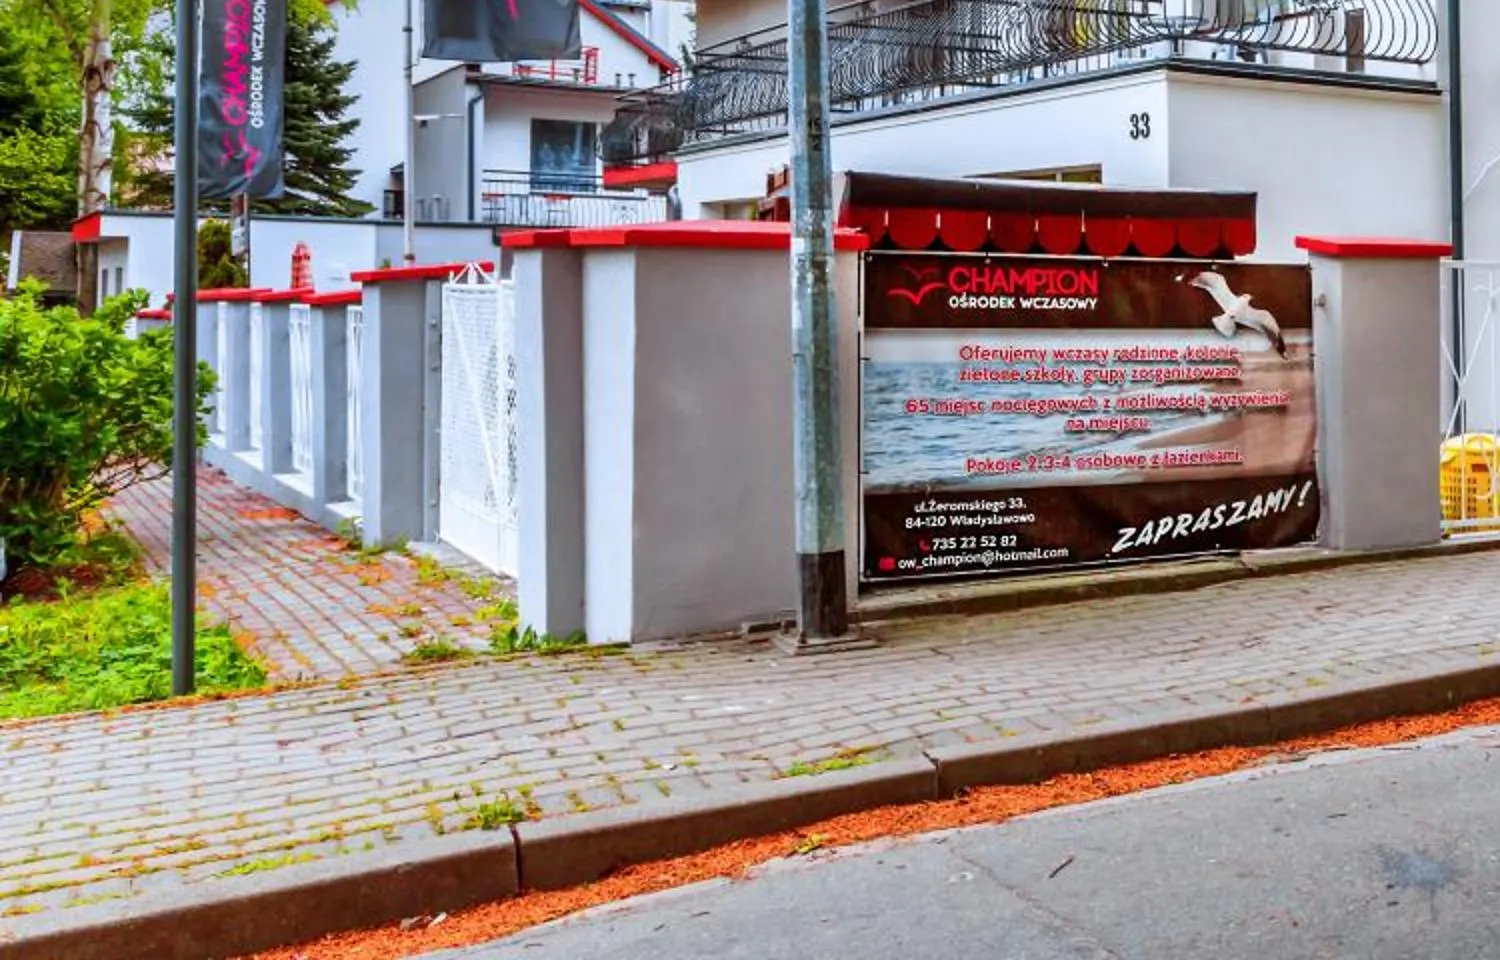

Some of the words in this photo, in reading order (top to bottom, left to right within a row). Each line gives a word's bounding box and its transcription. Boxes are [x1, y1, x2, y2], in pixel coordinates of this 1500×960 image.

[247, 66, 265, 129] OŚRODEK
[1129, 112, 1151, 140] 33
[948, 266, 1099, 295] CHAMPION
[949, 292, 1016, 309] OŚRODEK
[1020, 296, 1098, 310] WCZASOWY
[959, 345, 1047, 364] Oferujemy
[1053, 347, 1110, 364] wczasy
[1083, 368, 1126, 385] grupy
[904, 398, 929, 414] 65
[934, 397, 985, 415] miejsc
[1103, 397, 1111, 410] z
[1065, 418, 1085, 431] na
[965, 457, 1022, 474] Pokoje
[1075, 453, 1148, 469] osobowe
[1151, 452, 1160, 466] z
[904, 515, 947, 530] 84-120
[931, 538, 957, 551] 735
[959, 536, 977, 550] 22
[979, 535, 998, 548] 52
